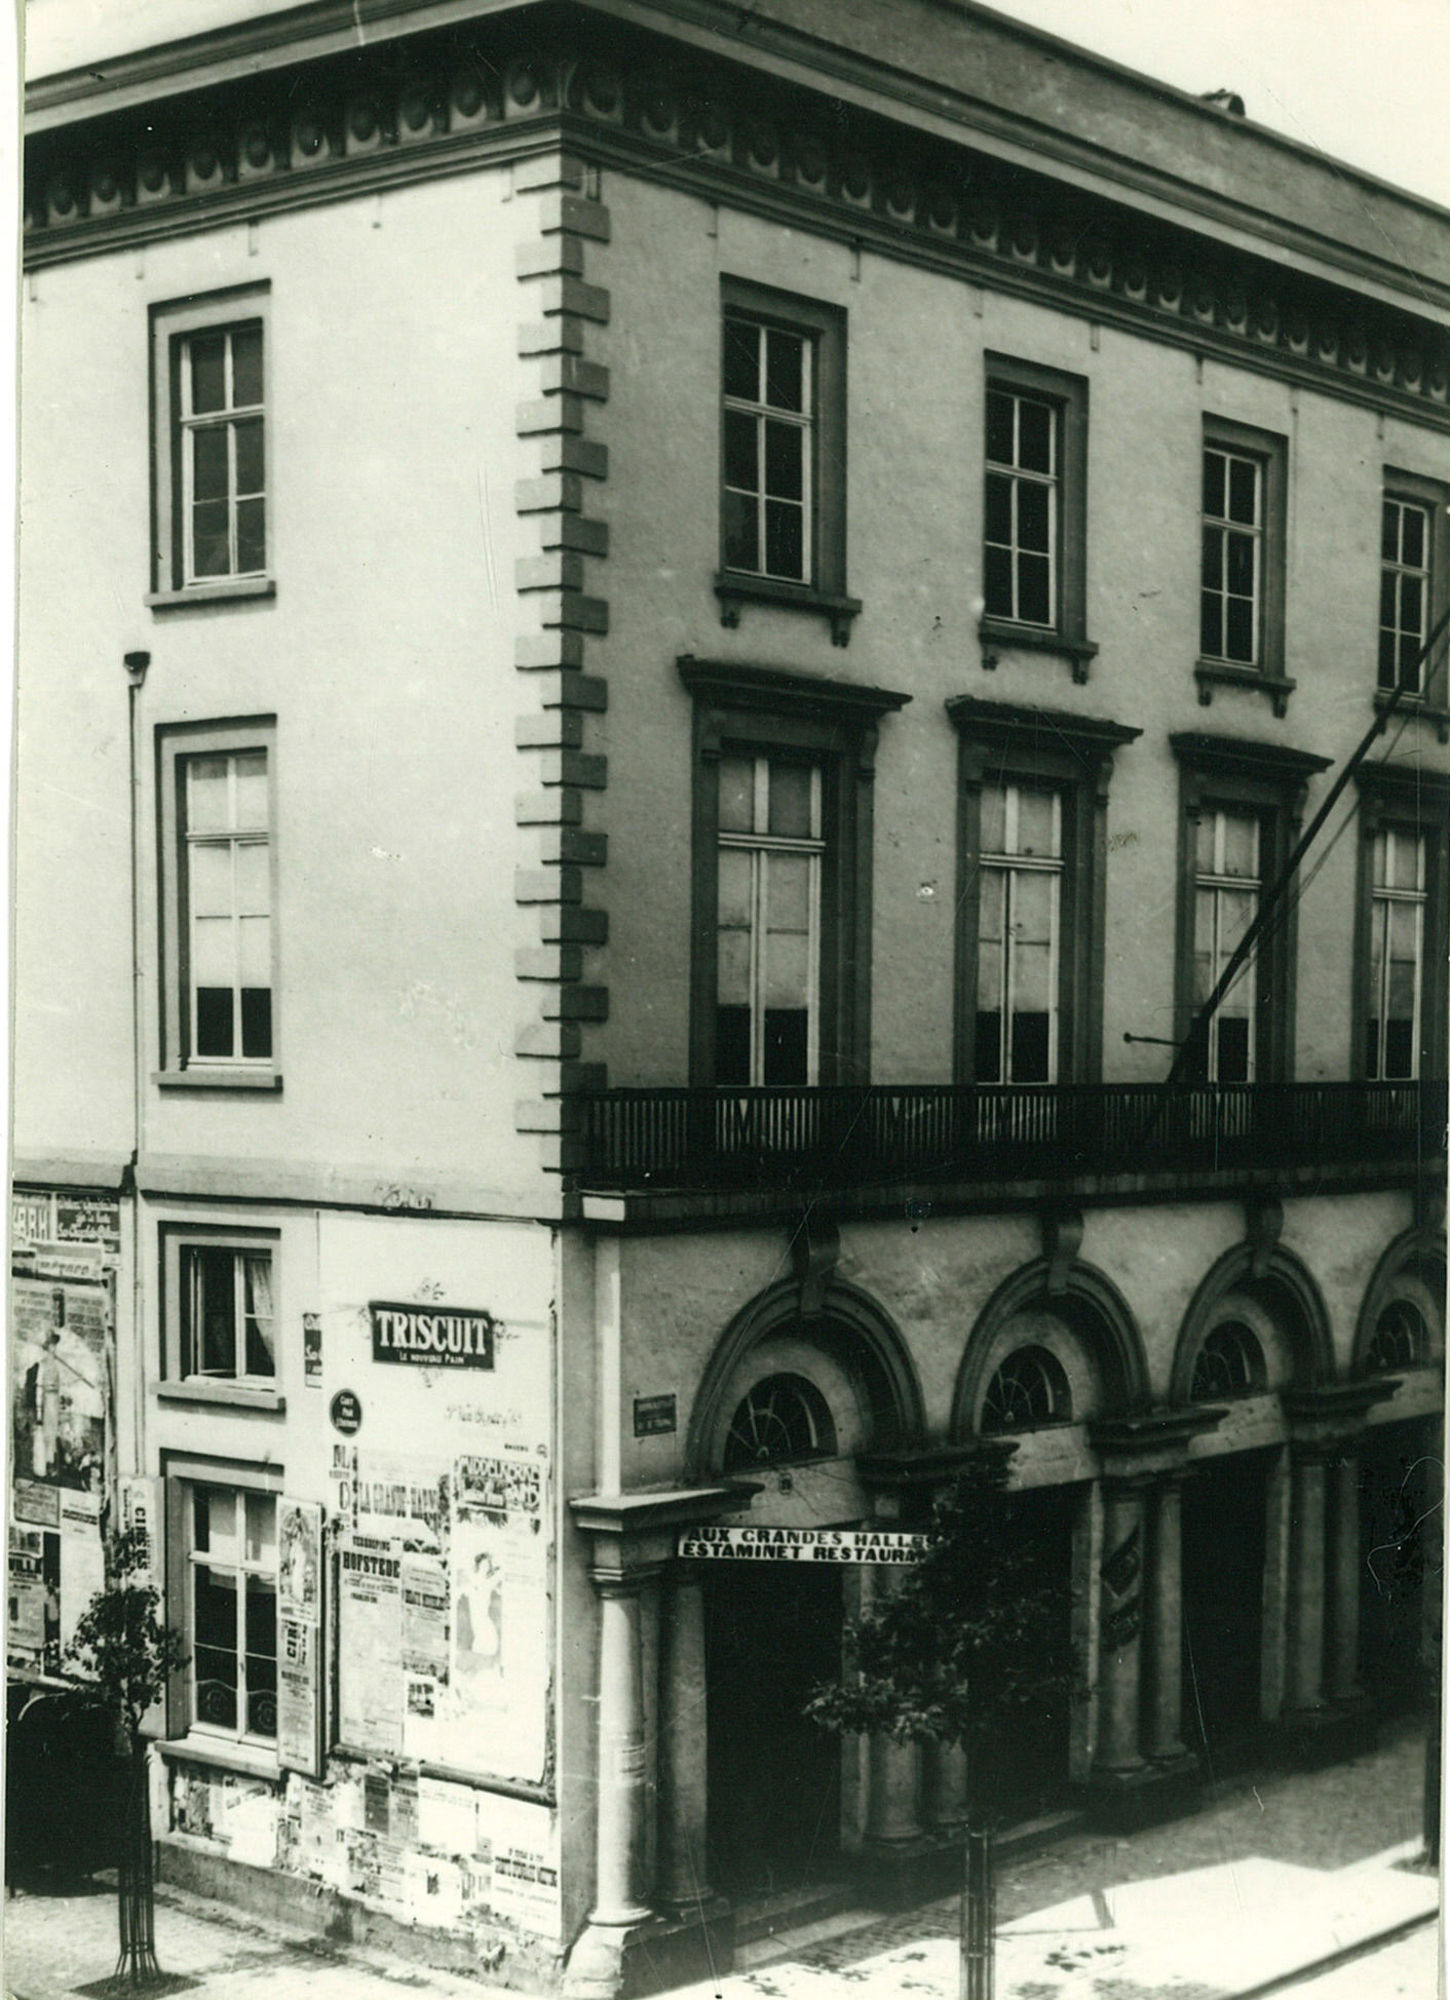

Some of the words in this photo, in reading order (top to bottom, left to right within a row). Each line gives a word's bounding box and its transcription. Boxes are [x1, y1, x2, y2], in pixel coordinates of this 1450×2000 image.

[375, 1310, 489, 1355] TRISCUIT
[688, 1528, 730, 1543] AUX
[741, 1529, 843, 1546] GRANDES
[343, 1550, 400, 1578] HOFSTEDE
[682, 1543, 803, 1559] ESTAMINET
[813, 1546, 922, 1563] RESTAURA
